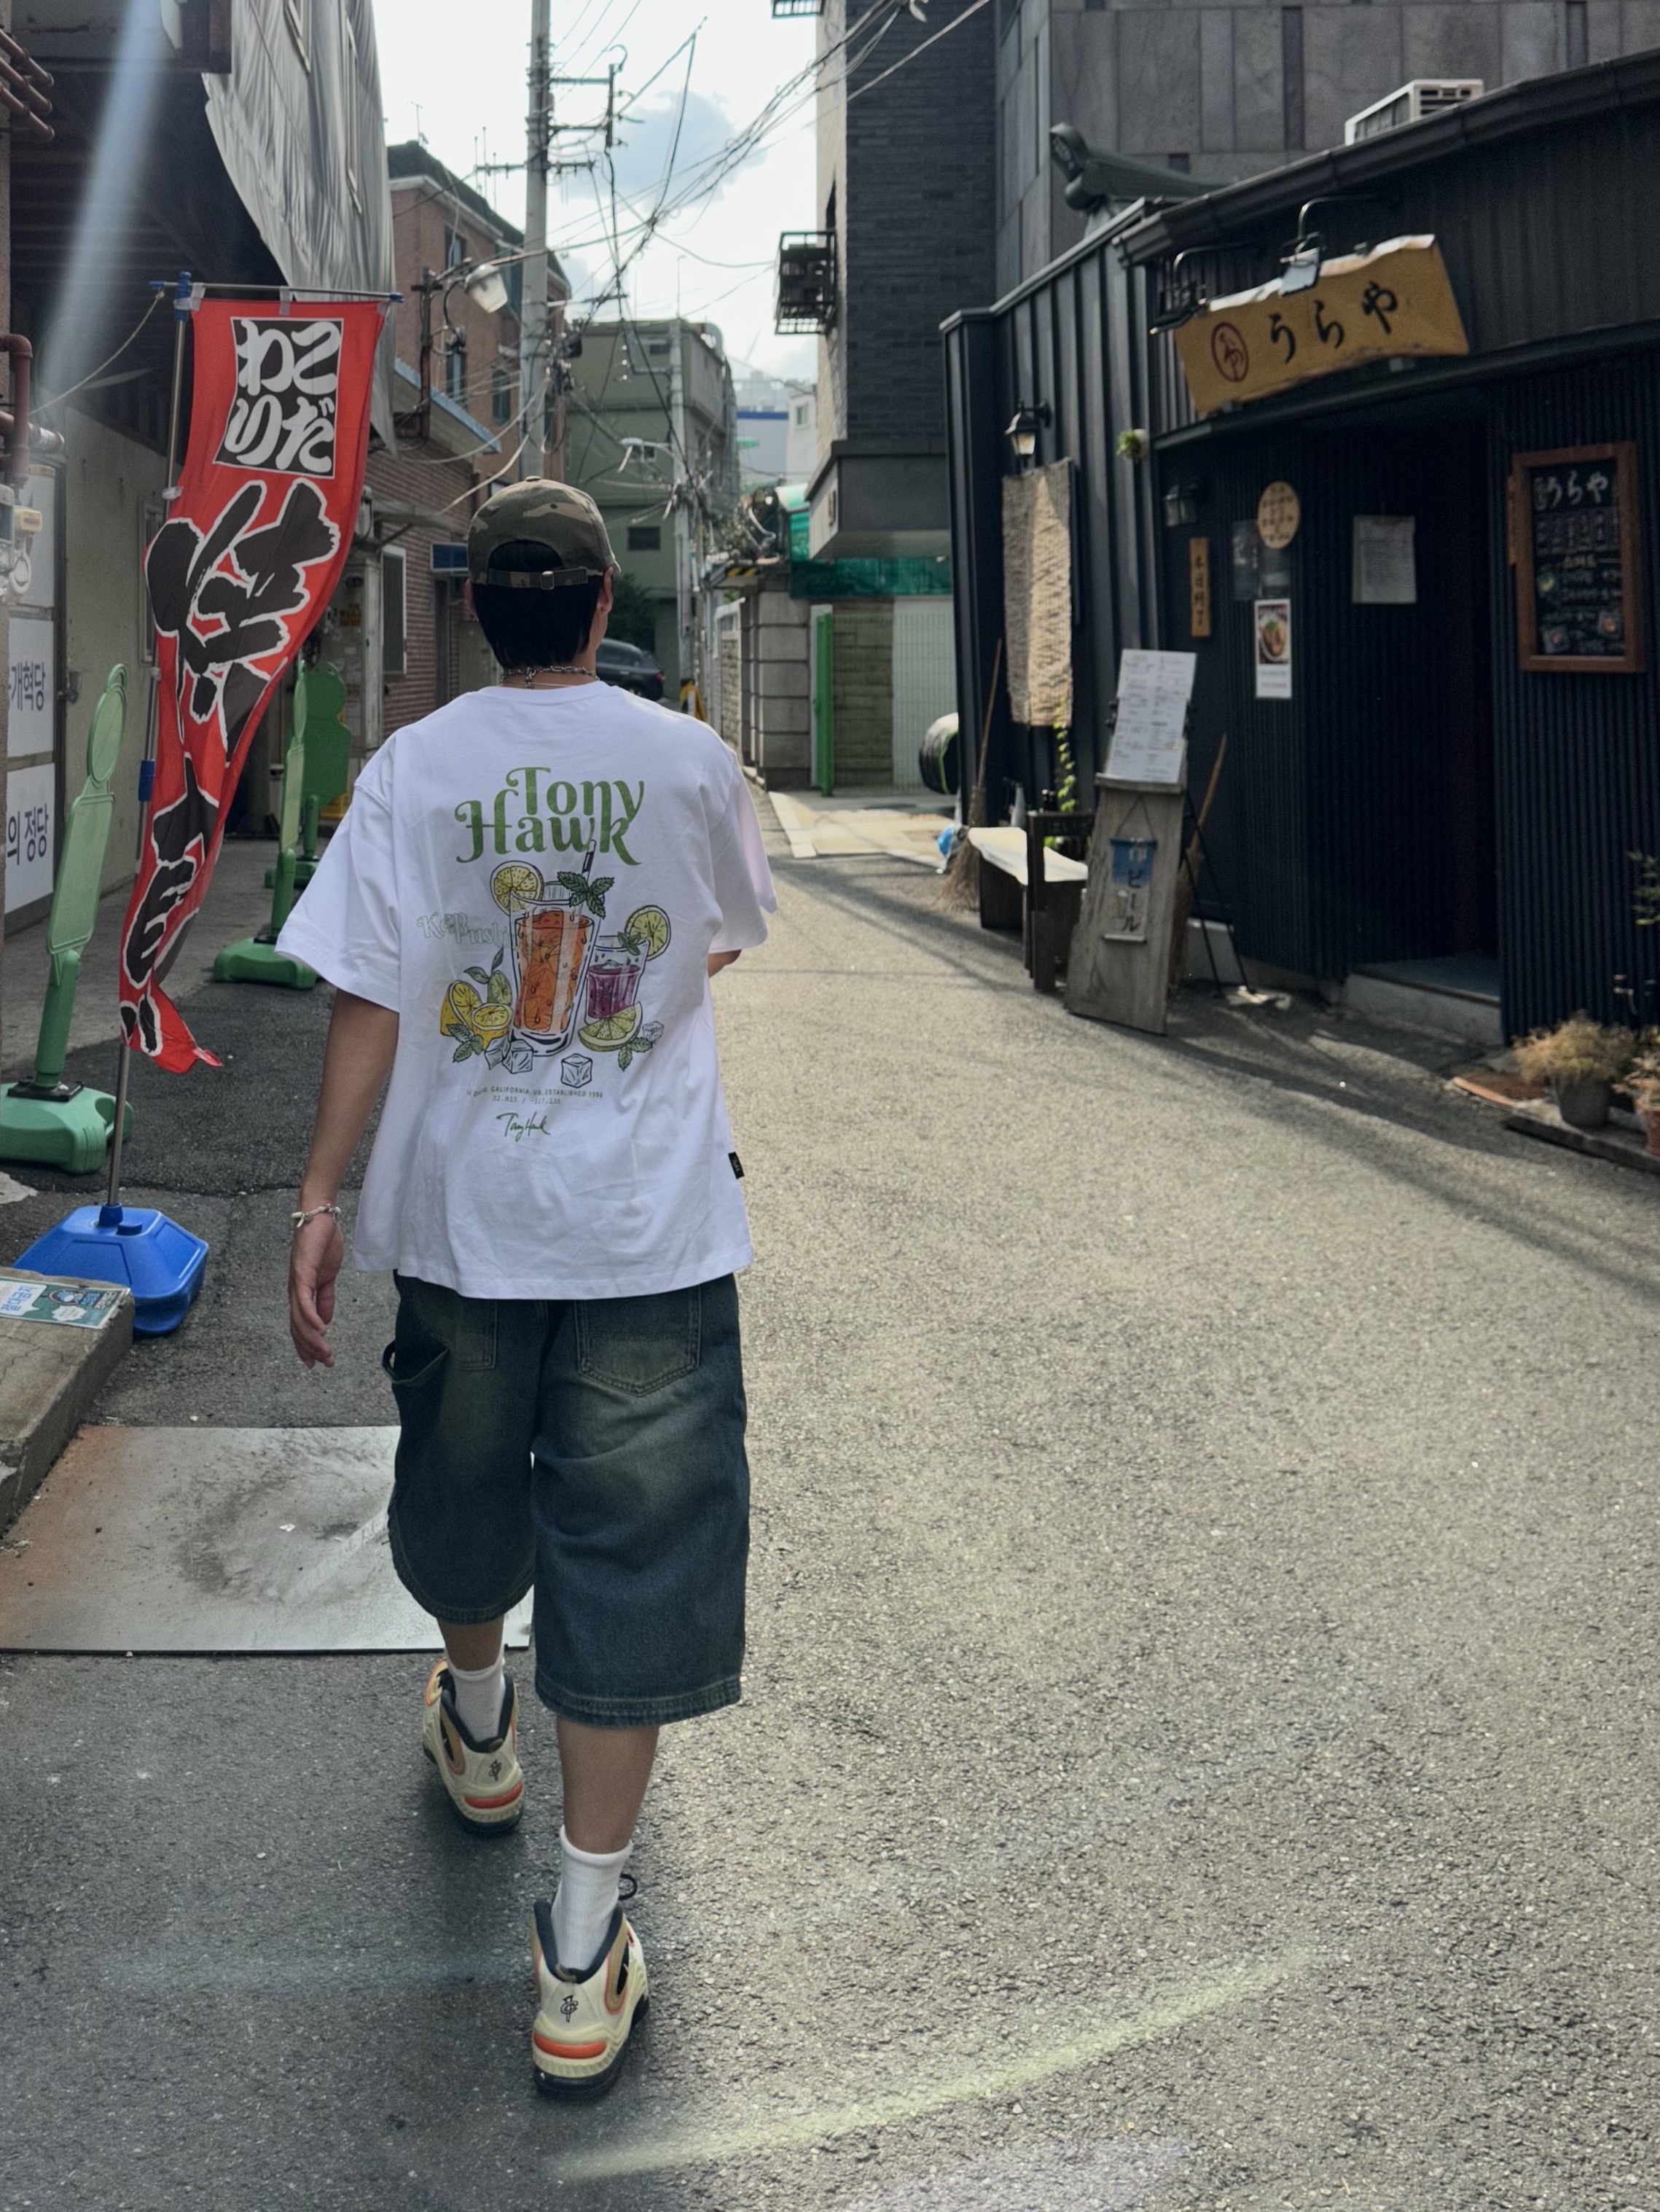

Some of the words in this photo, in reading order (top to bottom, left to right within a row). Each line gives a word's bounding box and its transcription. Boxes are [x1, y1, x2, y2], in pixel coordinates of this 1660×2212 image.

[1269, 280, 1398, 364] うらや
[8, 660, 46, 712] 개혁당
[505, 767, 645, 822] Tony
[24, 803, 49, 863] 정당
[454, 788, 642, 866] Hawk
